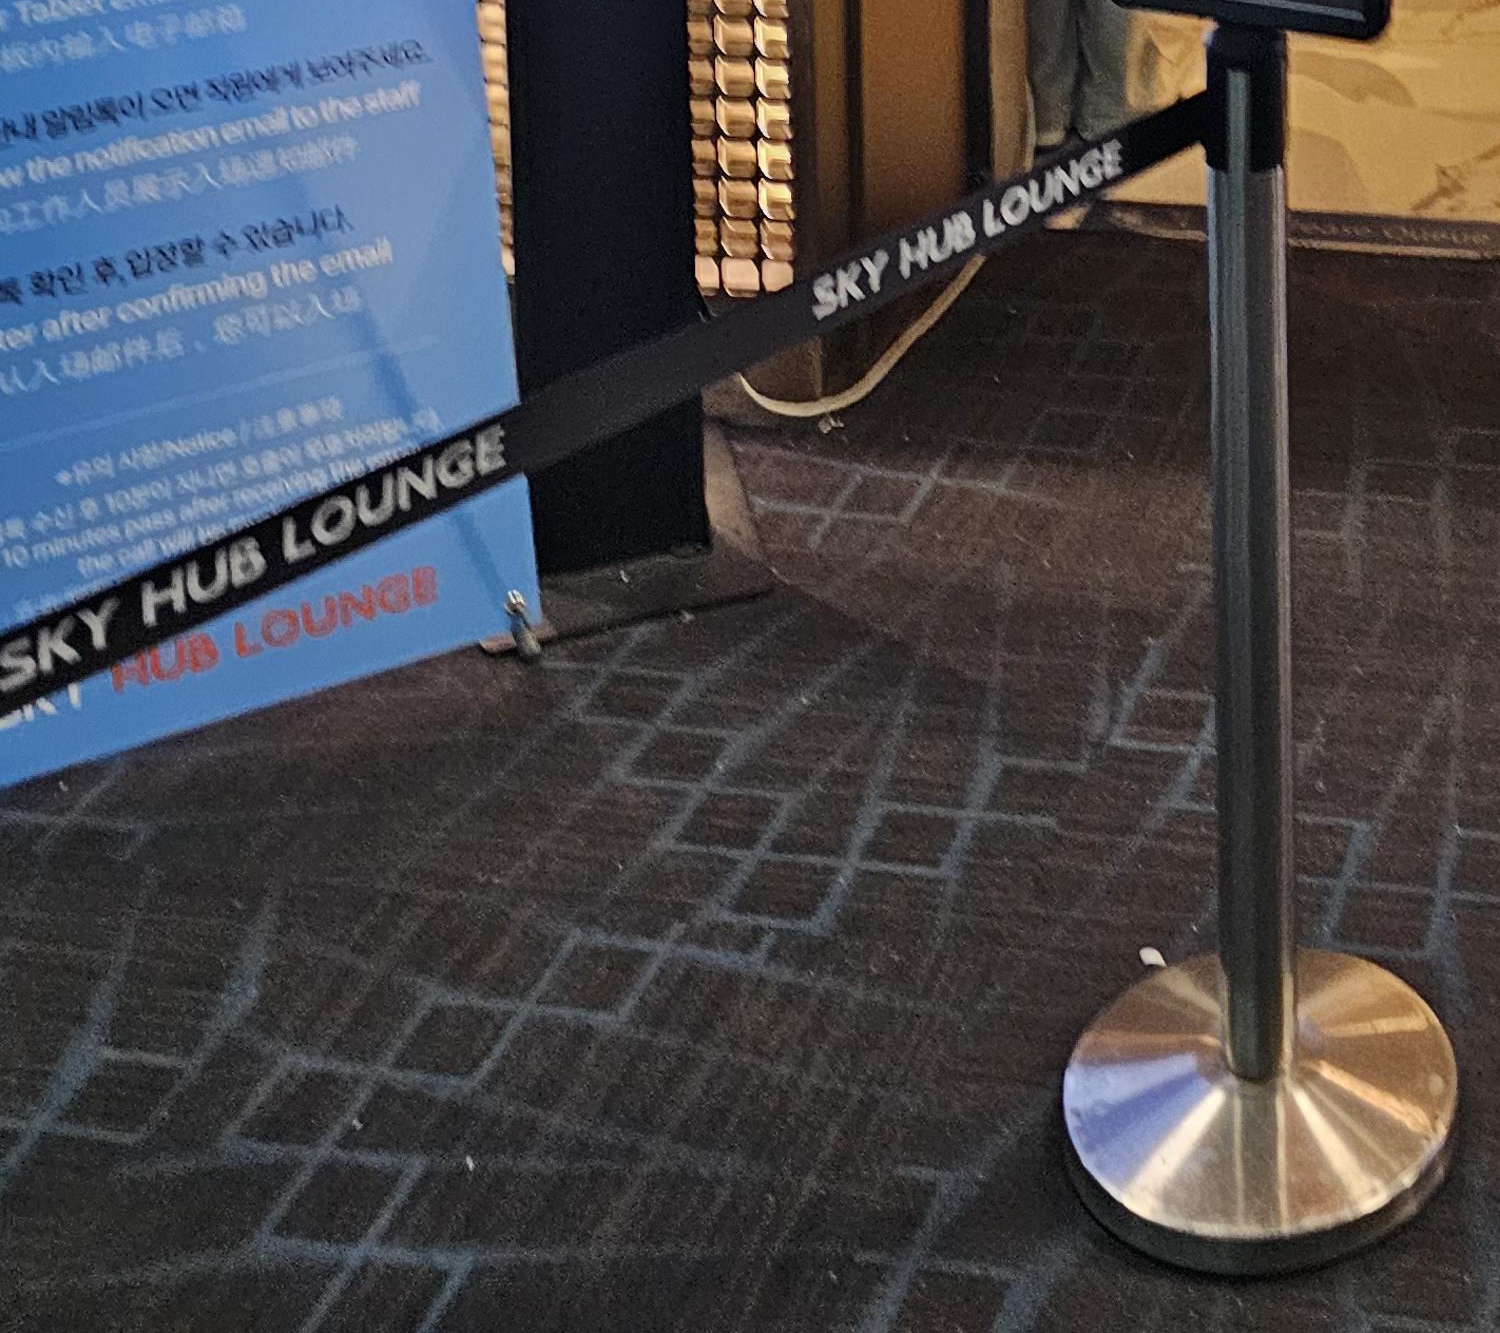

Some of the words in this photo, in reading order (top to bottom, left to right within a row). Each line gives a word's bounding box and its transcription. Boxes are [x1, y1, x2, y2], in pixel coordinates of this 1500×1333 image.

[25, 154, 75, 185] the
[74, 125, 222, 175] notification
[218, 106, 292, 145] email
[289, 102, 322, 131] to
[318, 93, 366, 125] the
[361, 78, 423, 116] staff
[40, 305, 113, 342] after
[114, 269, 269, 323] confirming
[269, 259, 319, 289] the
[318, 235, 395, 278] email
[812, 247, 890, 322] SKY
[898, 208, 978, 281] HUB
[982, 137, 1125, 239] LOUNGE
[0, 595, 121, 693] SKY
[140, 534, 269, 630] HUB
[280, 423, 508, 566] LOUNGE
[110, 631, 222, 694] HUB
[232, 564, 441, 661] LOUNGE
